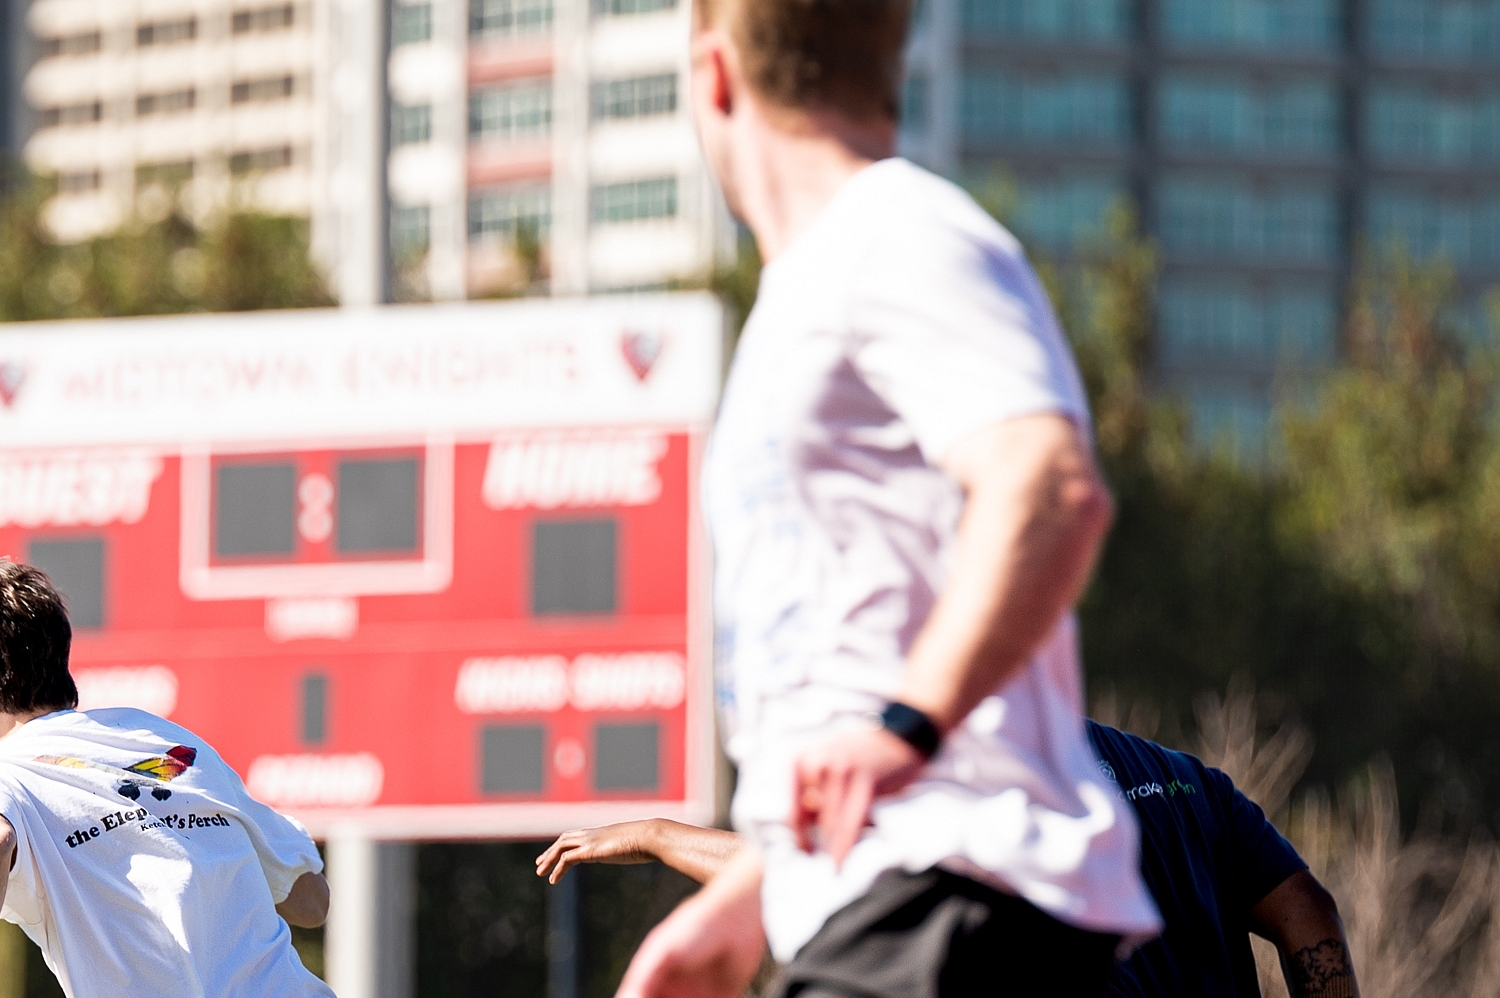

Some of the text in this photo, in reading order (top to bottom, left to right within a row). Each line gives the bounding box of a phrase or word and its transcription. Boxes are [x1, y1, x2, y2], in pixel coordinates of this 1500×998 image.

[65, 807, 230, 849] the Elept's Perch
